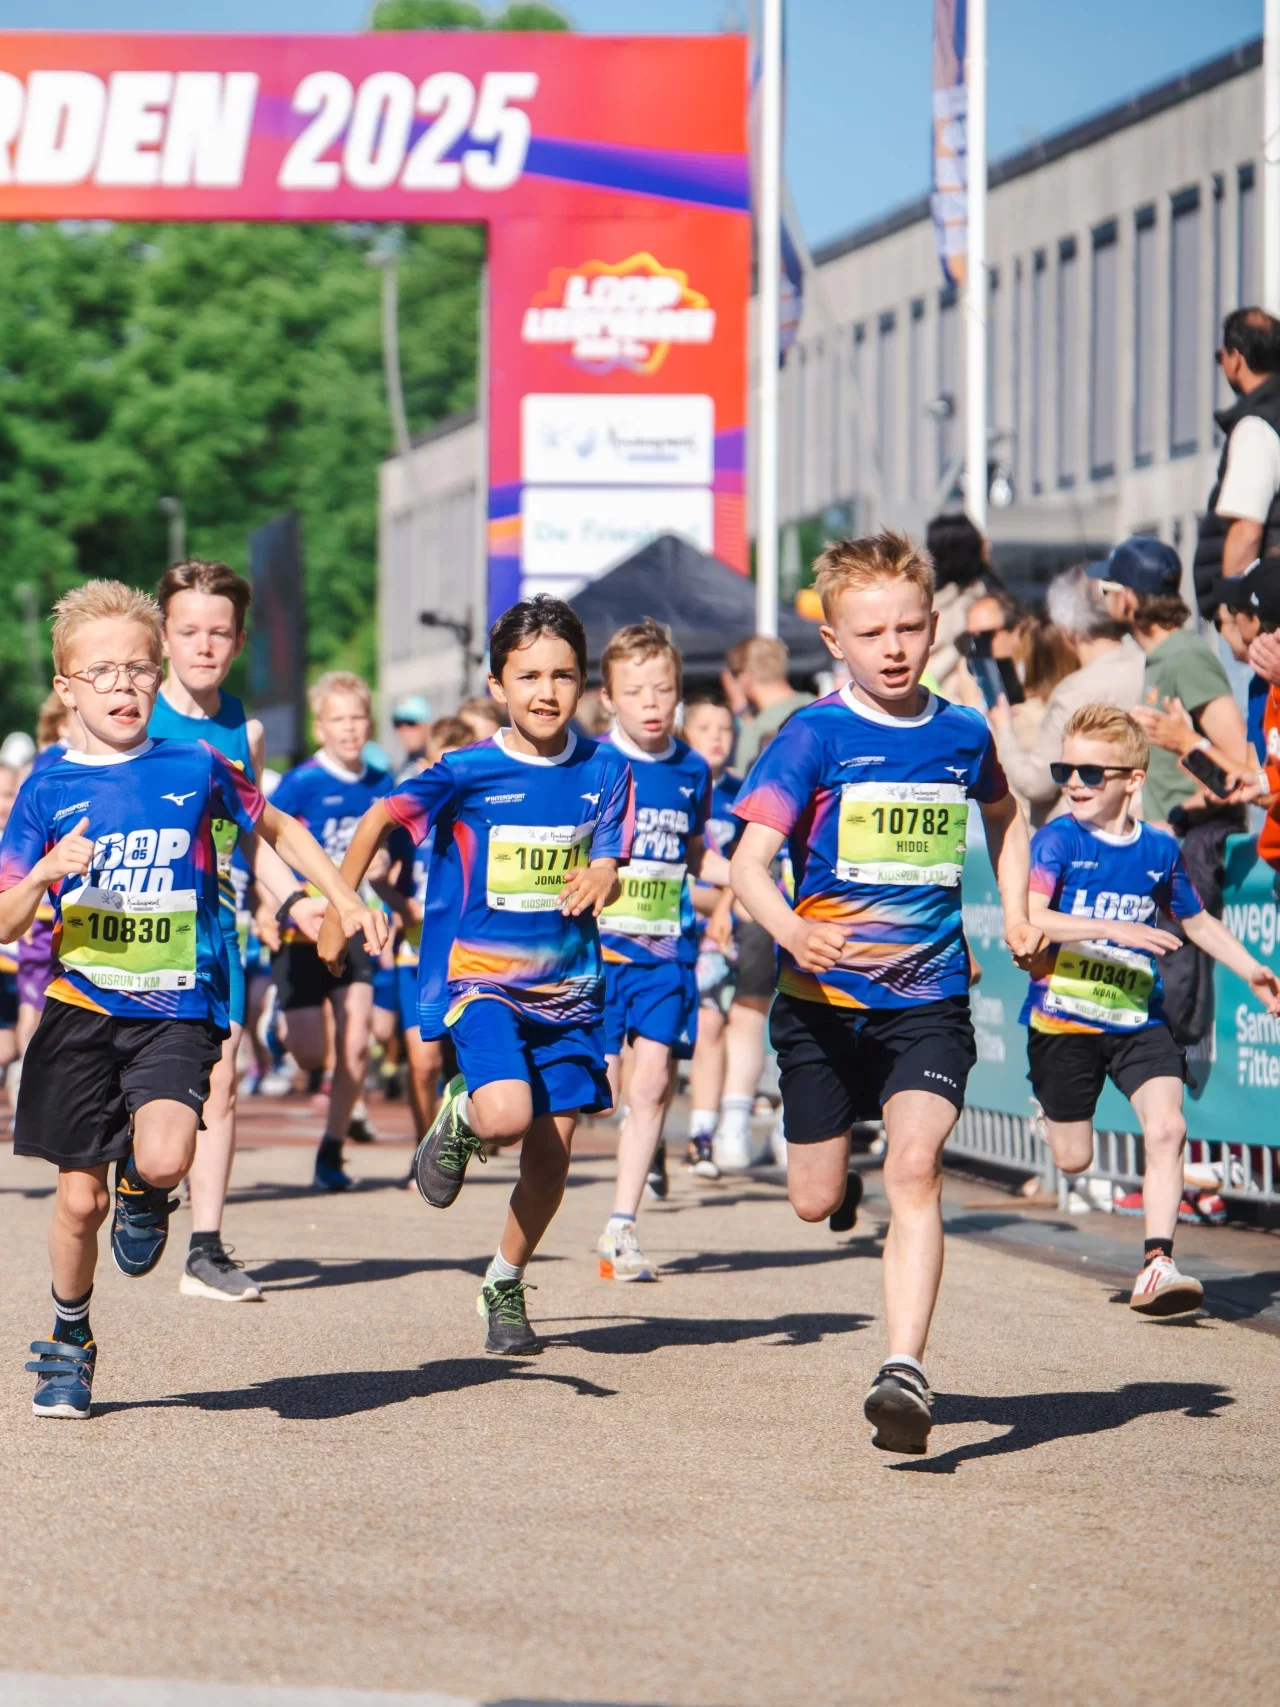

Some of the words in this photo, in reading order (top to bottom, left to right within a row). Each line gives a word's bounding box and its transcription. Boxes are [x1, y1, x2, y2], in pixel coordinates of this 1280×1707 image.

[277, 70, 539, 191] 2025
[563, 274, 683, 309] LOOP
[871, 807, 949, 836] 10782
[91, 828, 191, 871] OOP
[130, 849, 148, 860] 05
[135, 837, 148, 848] 11
[515, 843, 581, 871] 10771
[896, 840, 930, 853] HIDDE
[1070, 888, 1156, 922] LOOP
[87, 912, 171, 944] 10830
[91, 972, 134, 987] KIDSRUN
[136, 976, 141, 987] 1
[143, 976, 161, 988] KM
[1078, 959, 1138, 991] 10341
[923, 1069, 957, 1089] KIPSTA
